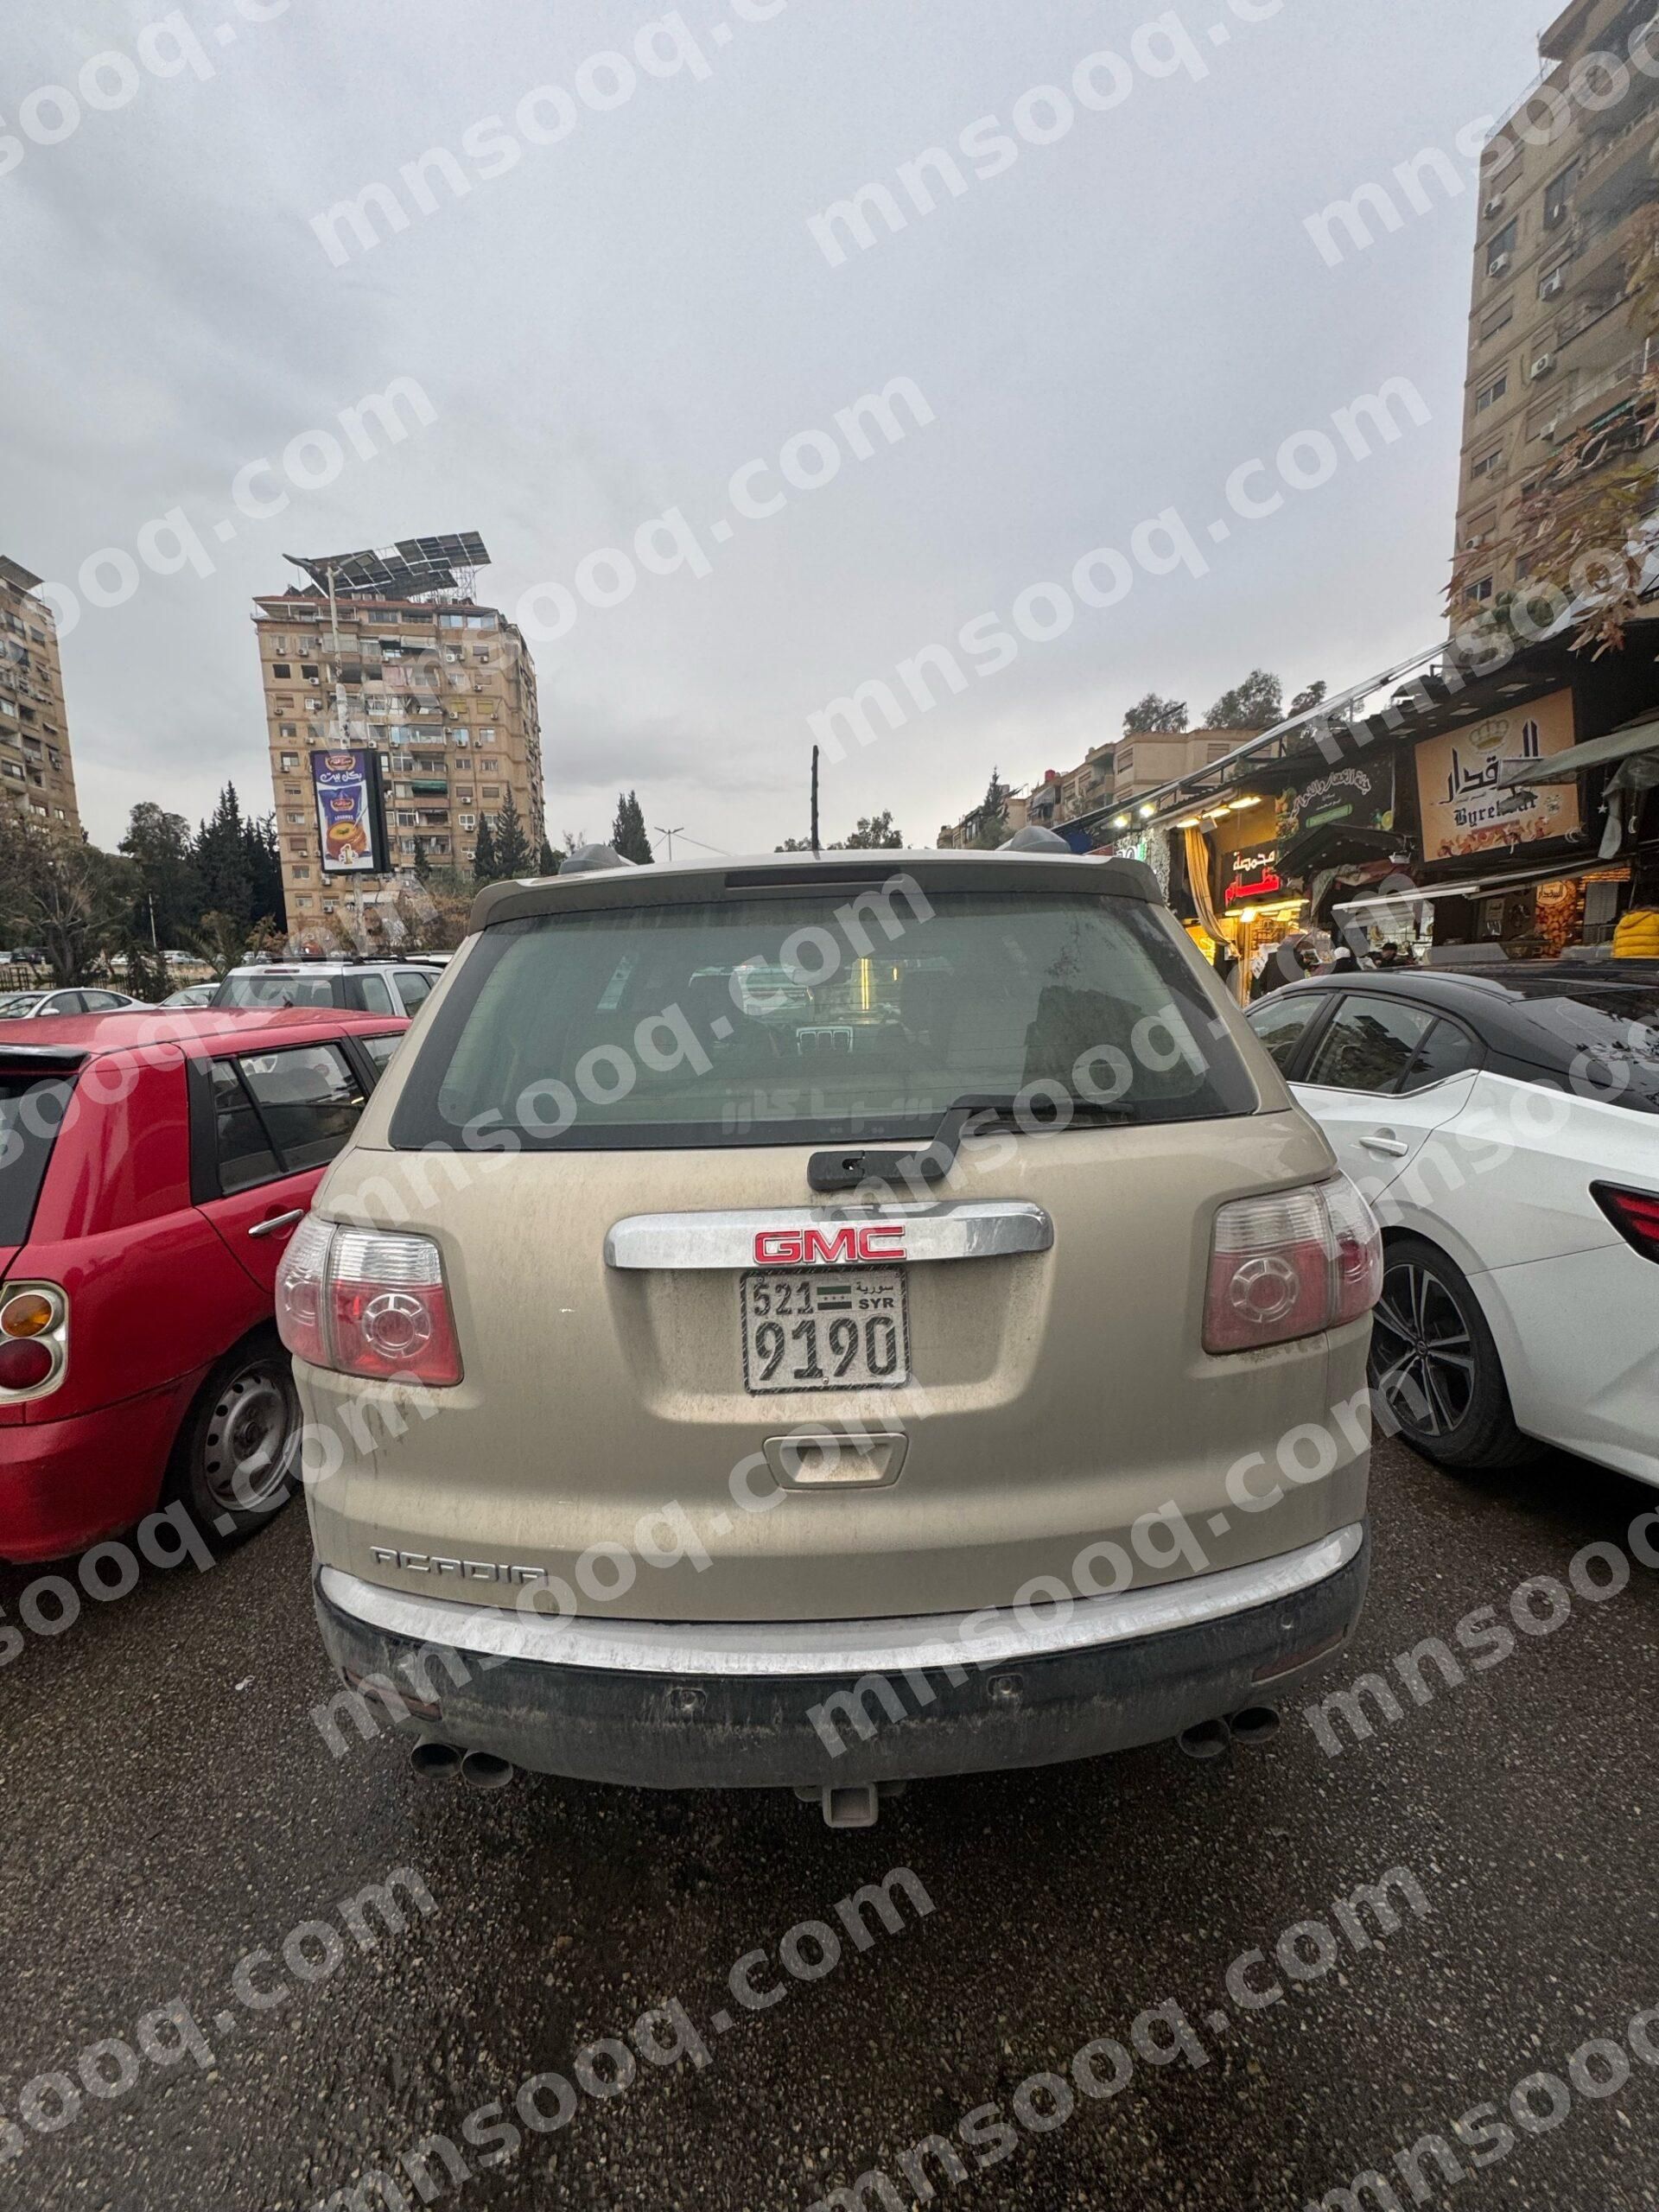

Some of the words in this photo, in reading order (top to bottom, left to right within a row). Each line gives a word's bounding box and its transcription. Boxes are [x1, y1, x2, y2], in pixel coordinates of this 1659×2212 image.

[1438, 719, 1540, 804] القدار
[1453, 799, 1536, 827] Byrer
[1233, 850, 1275, 871] محمصة
[754, 1224, 906, 1264] GMC
[753, 1281, 814, 1316] 521
[855, 1281, 894, 1294] سورية
[859, 1298, 894, 1309] SYR
[755, 1317, 897, 1381] 9190
[370, 1546, 549, 1586] ACADIA
